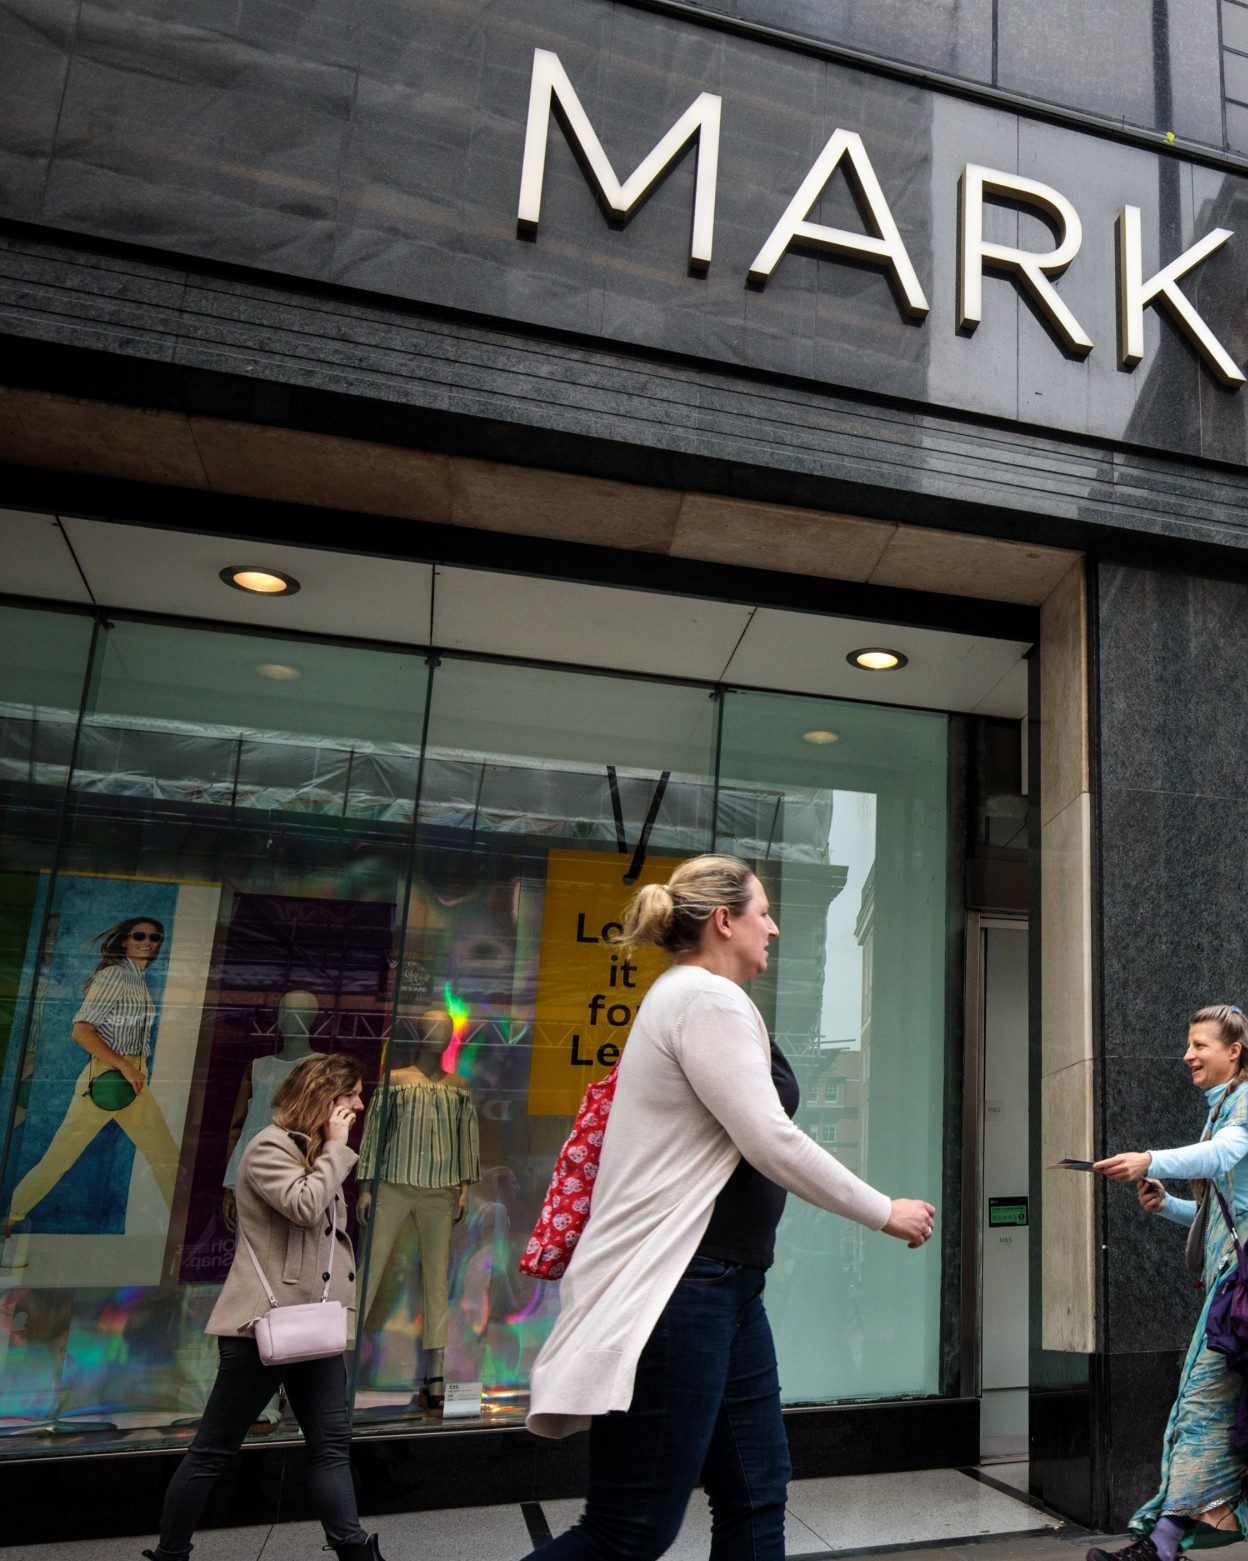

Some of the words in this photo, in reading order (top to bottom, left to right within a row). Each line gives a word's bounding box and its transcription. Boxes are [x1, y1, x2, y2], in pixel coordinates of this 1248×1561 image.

[576, 912, 625, 944] Lo
[609, 954, 638, 988] it
[588, 994, 640, 1027] fo
[570, 1034, 620, 1067] Le
